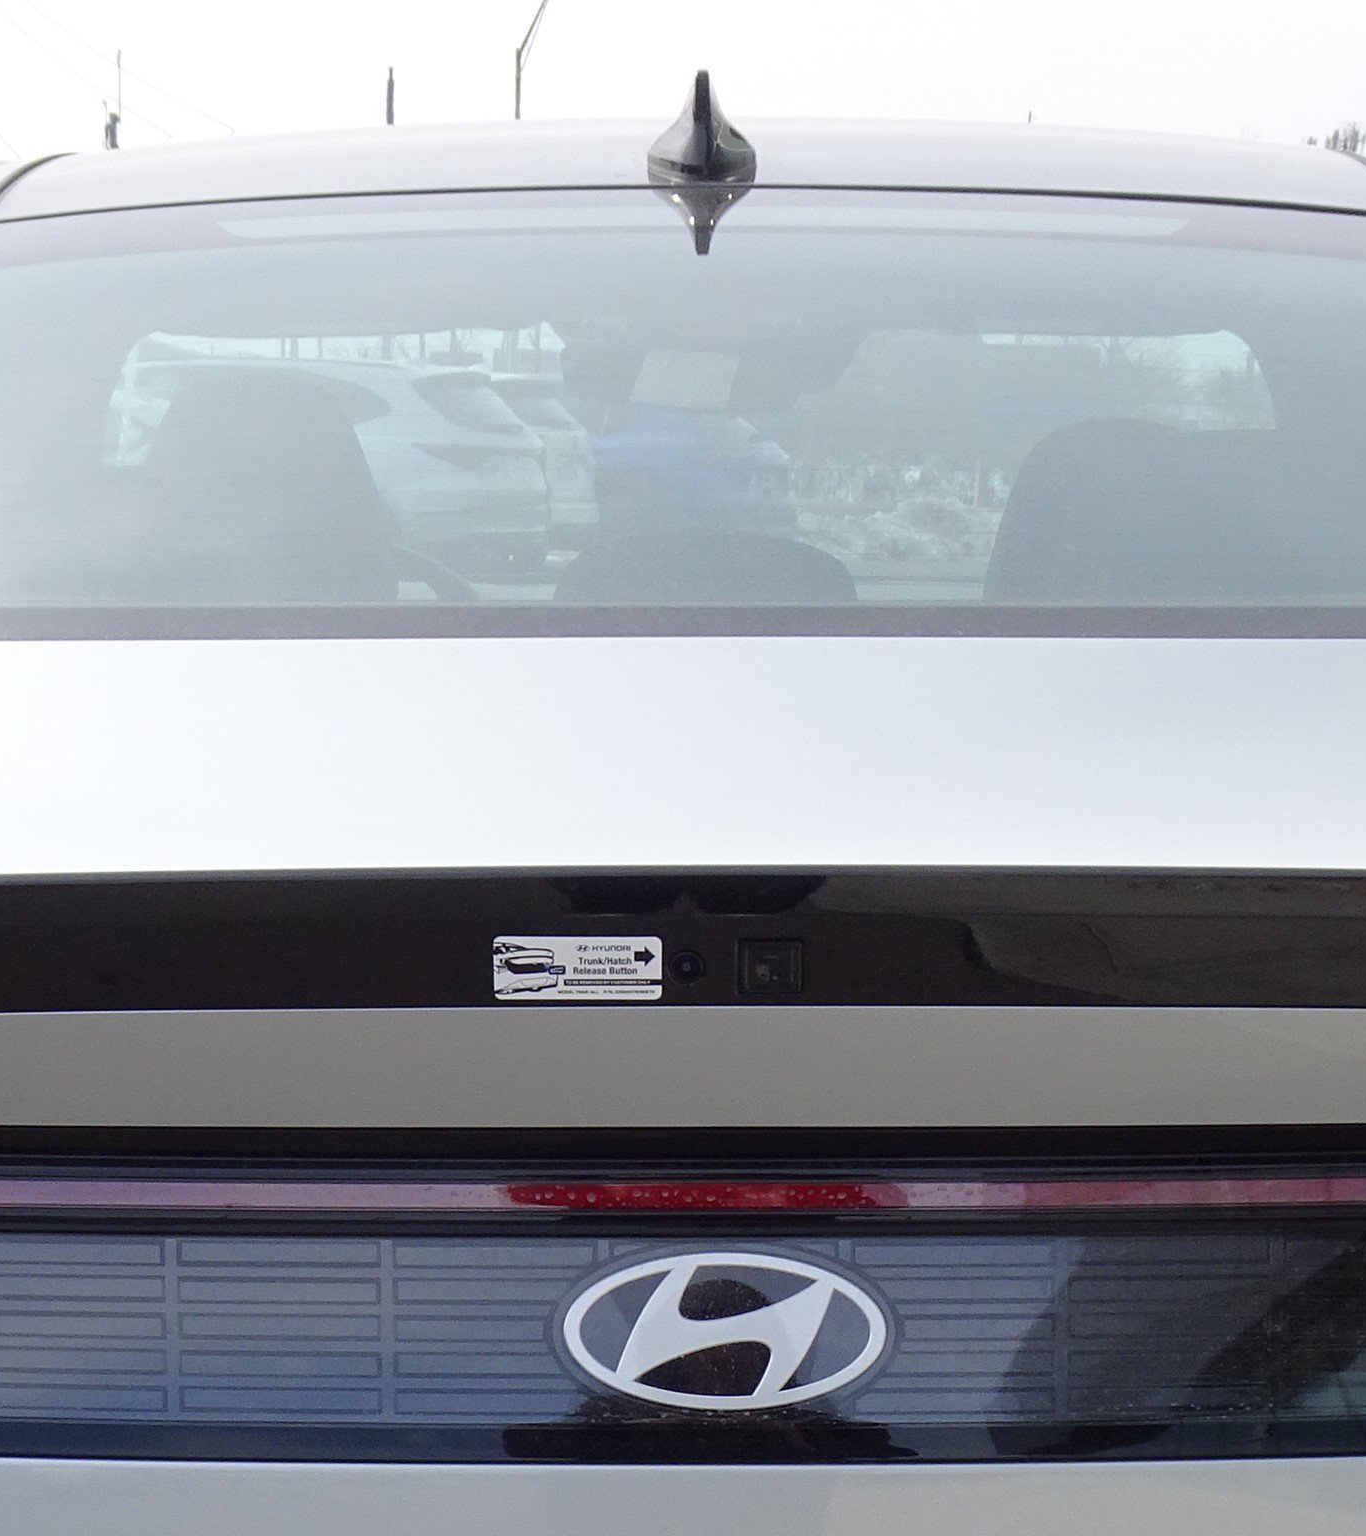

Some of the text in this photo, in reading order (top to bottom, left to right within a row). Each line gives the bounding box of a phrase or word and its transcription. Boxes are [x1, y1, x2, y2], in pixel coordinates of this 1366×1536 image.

[578, 957, 632, 966] Trunk/Hatch
[573, 967, 638, 975] Release Button
